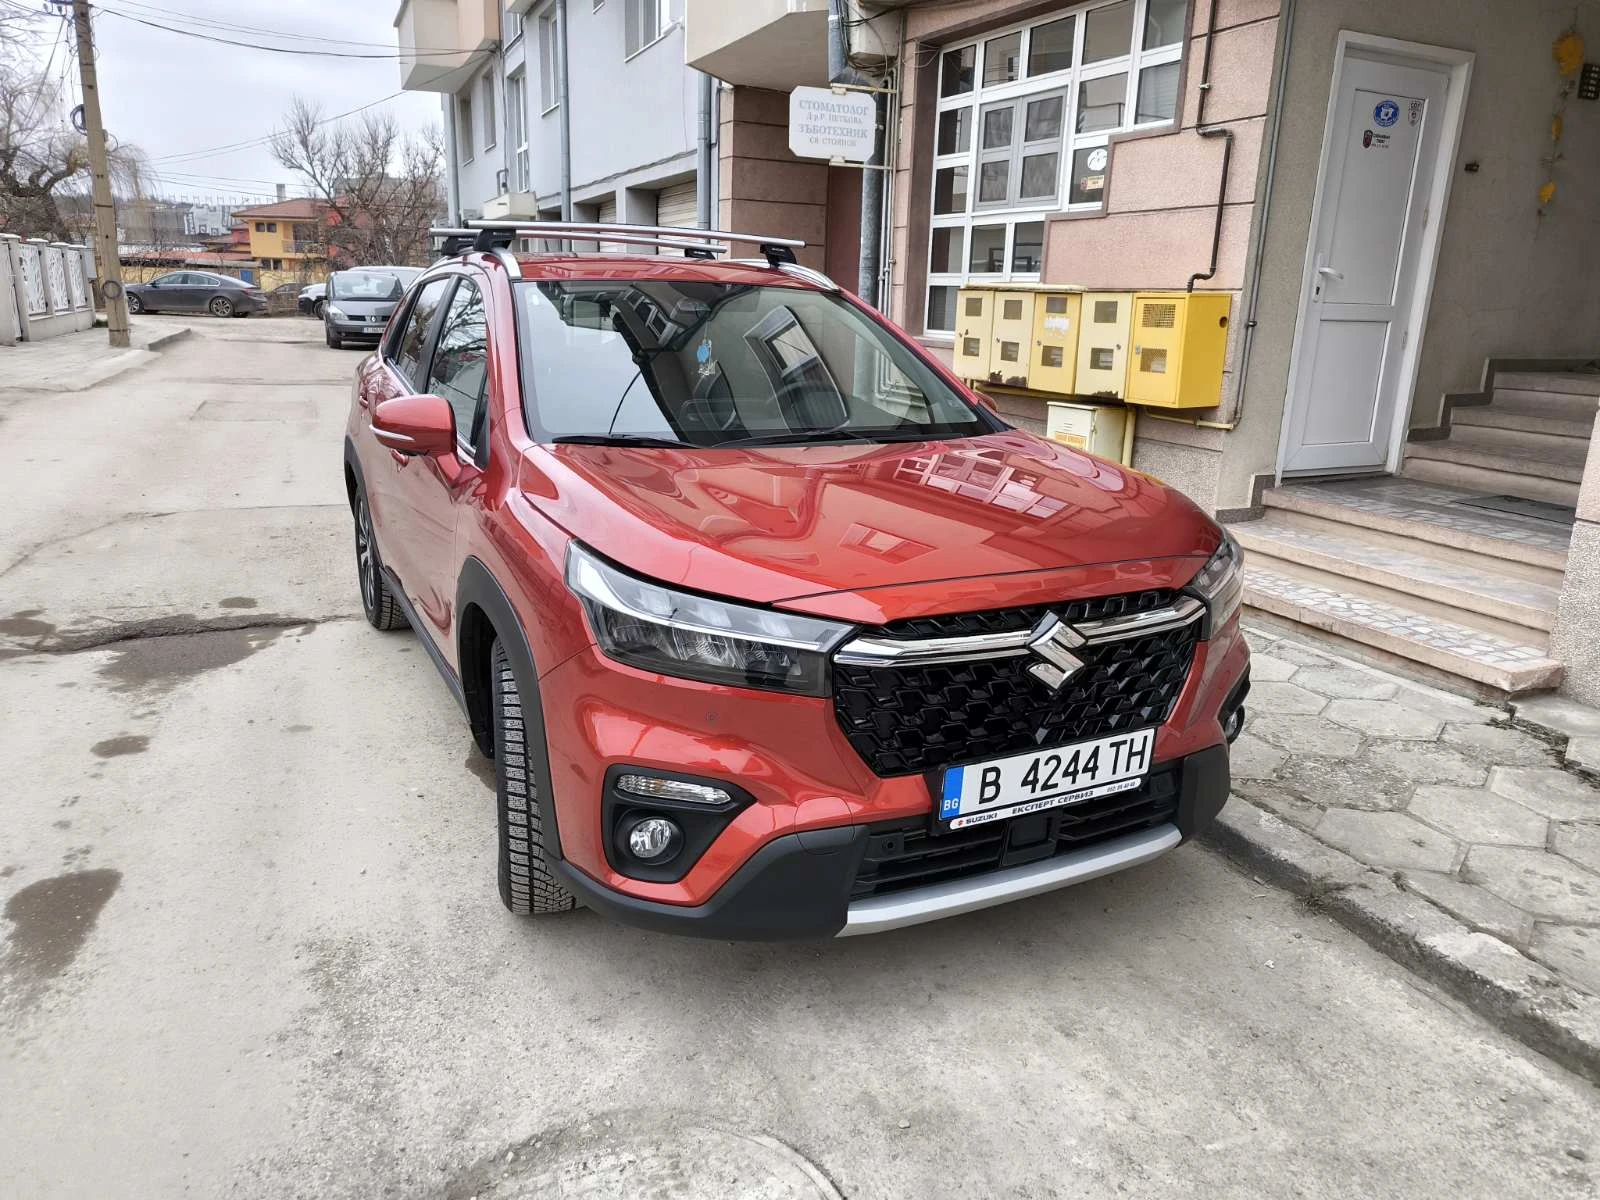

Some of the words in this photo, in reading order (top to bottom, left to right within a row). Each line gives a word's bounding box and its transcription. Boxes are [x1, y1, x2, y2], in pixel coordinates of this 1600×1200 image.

[799, 99, 869, 116] СТОМАТОЛОГ
[978, 766, 1001, 804] B
[1020, 745, 1101, 794] 4244
[1109, 735, 1148, 776] TH
[943, 798, 959, 811] BG
[1011, 800, 1054, 815] ЕКСПЕРТ
[1057, 790, 1094, 804] СЕРВИЗ
[966, 812, 998, 825] SUZUKI
